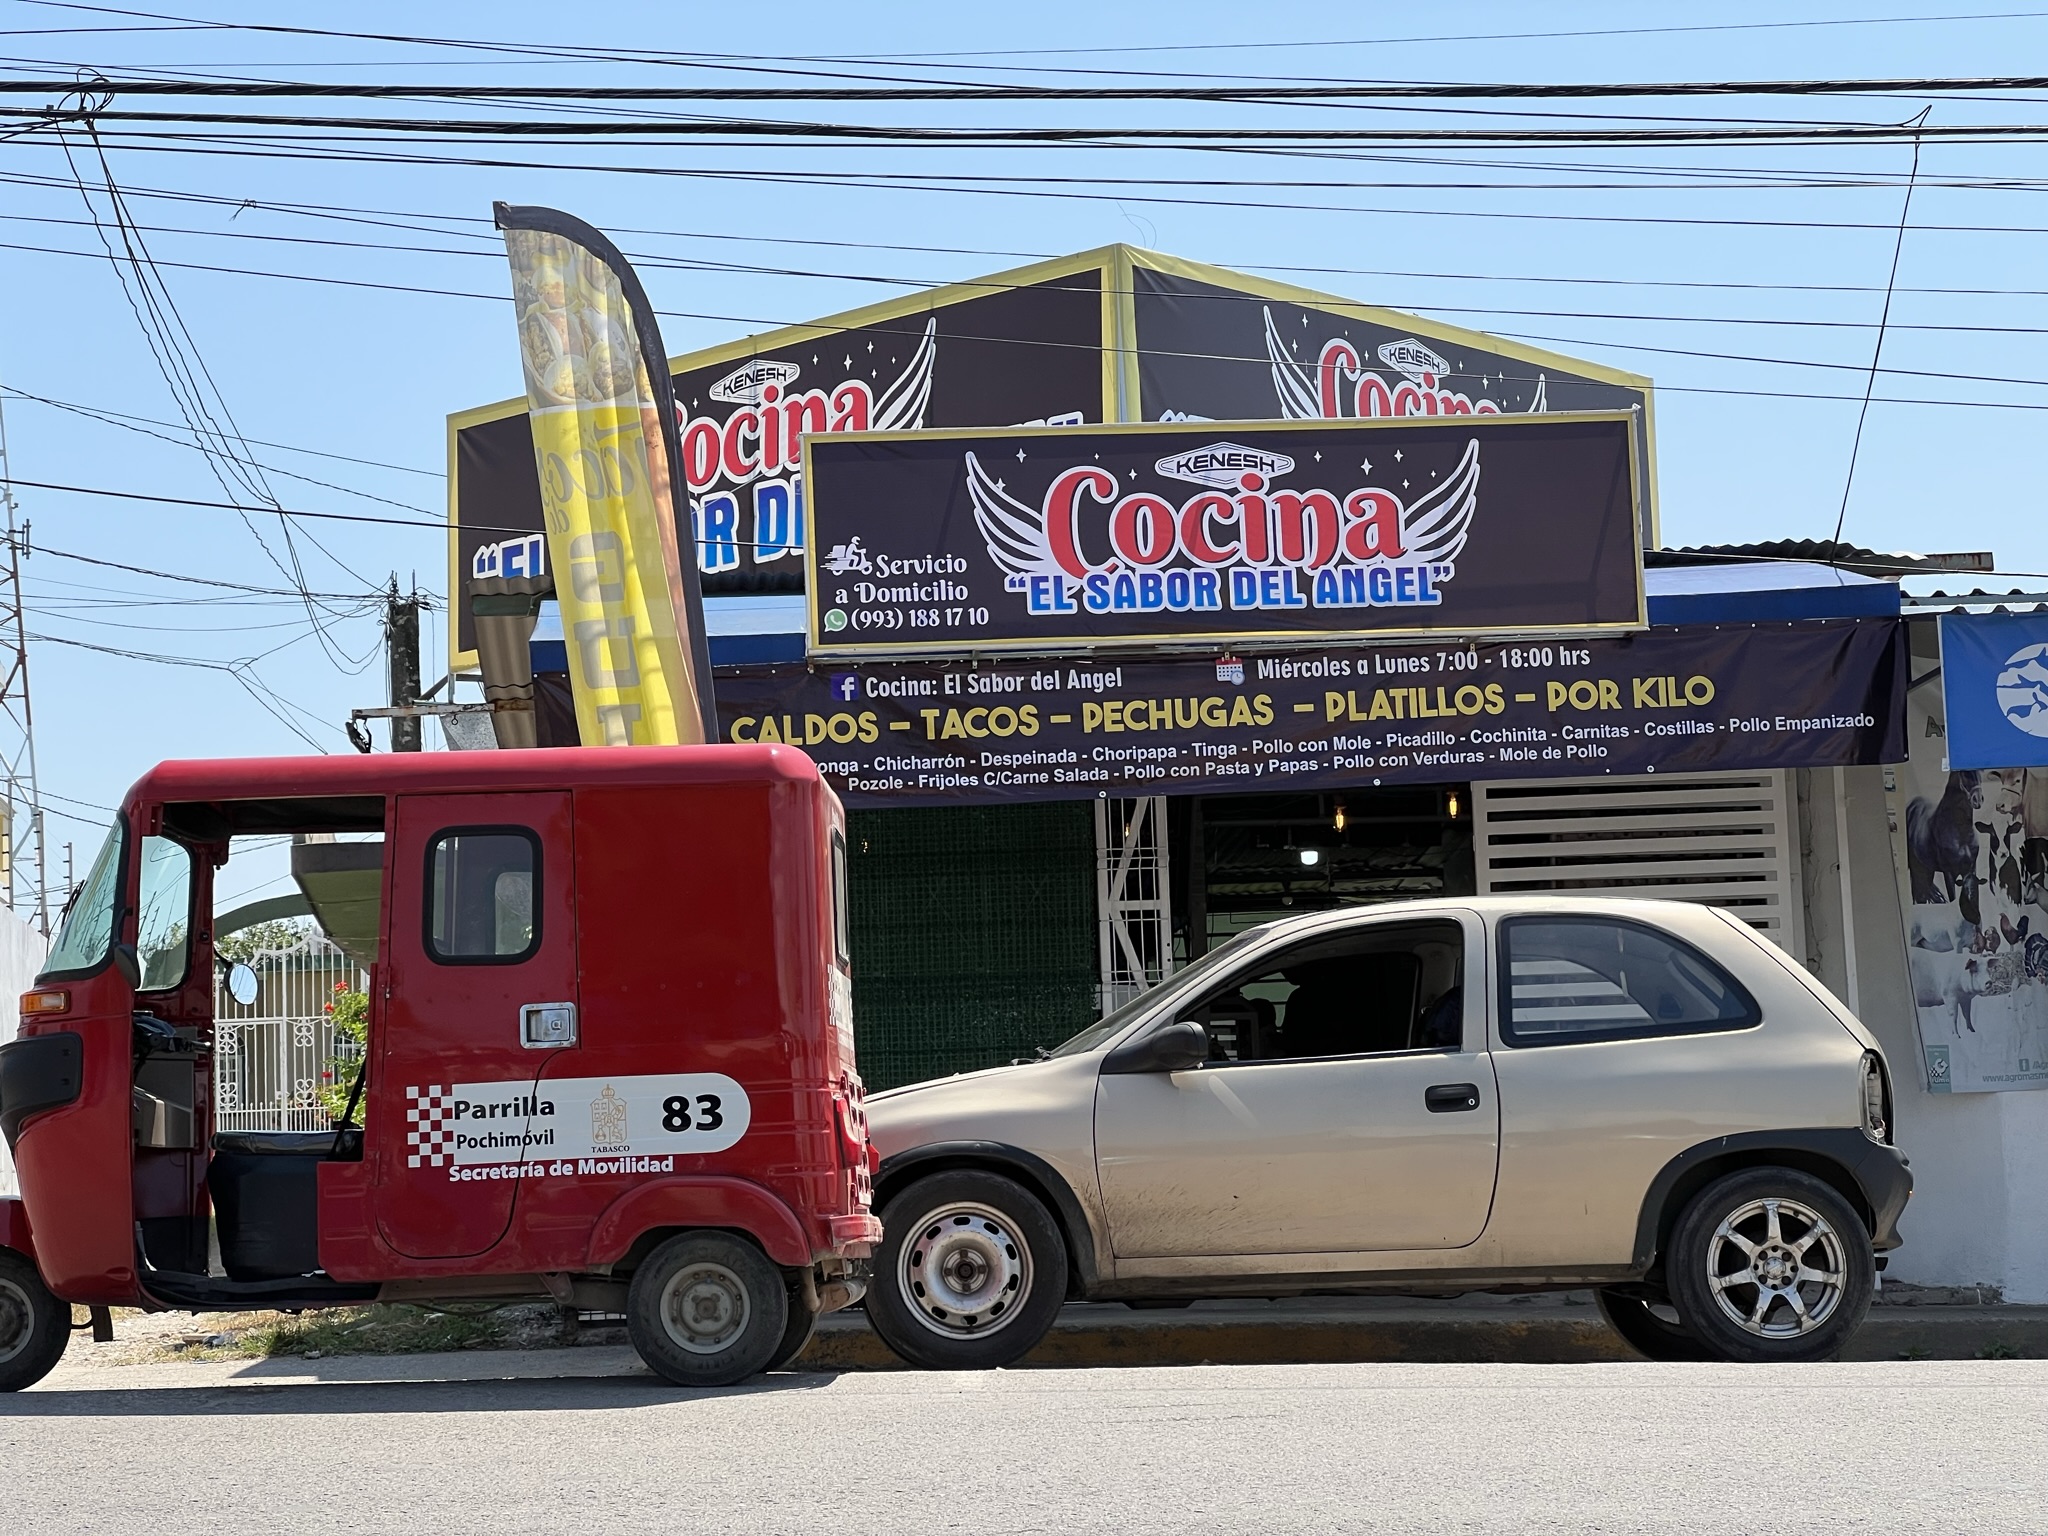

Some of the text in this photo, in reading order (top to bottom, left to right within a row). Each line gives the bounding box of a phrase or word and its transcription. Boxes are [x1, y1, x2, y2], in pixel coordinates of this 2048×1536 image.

[1388, 347, 1441, 374] KENESH
[722, 366, 787, 396] KENESH
[675, 384, 869, 486] ocina
[1177, 454, 1275, 473] KENESH
[1046, 469, 1407, 579] Cocina
[876, 554, 968, 578] Servicio
[835, 580, 969, 604] a Domicilio
[1086, 571, 1219, 610] SABOR
[1233, 569, 1303, 606] DEL
[851, 607, 990, 630] (993) 188 17 10
[1257, 654, 1352, 680] Miércoles
[1357, 661, 1369, 675] a
[1374, 653, 1430, 674] Lunes
[1436, 651, 1479, 672] 7:00
[1499, 647, 1553, 668] 18:00
[1559, 645, 1591, 666] hrs
[865, 667, 1123, 698] Cocina: El Sabor del Angel
[730, 711, 880, 745] CALDOS
[920, 704, 1040, 740] TACOS
[1083, 693, 1275, 734] PECHUGAS
[1325, 683, 1506, 722] PLATILLOS
[1546, 679, 1622, 712] POR
[1632, 675, 1716, 709] KILO
[873, 754, 965, 772] Chicharrón
[980, 748, 1078, 769] Despeinada
[1092, 745, 1177, 767] Choripapa
[1191, 742, 1237, 761] Tinga
[1252, 739, 1294, 755] Pollo
[1297, 741, 1329, 754] con
[1333, 736, 1372, 751] Mole
[1386, 731, 1455, 748] Picadillo
[1470, 725, 1547, 745] Cochinita
[1561, 723, 1630, 741] Carnitas
[1644, 719, 1715, 738] Costillas
[1729, 716, 1771, 733] Pollo
[1775, 712, 1875, 735] Empanizado
[848, 776, 903, 791] Pozole
[918, 773, 979, 790] Frijoles
[983, 769, 1049, 787] C/Carne
[1053, 767, 1110, 784] Salada
[1124, 763, 1166, 780] Pollo
[1170, 765, 1200, 778] con
[1205, 760, 1250, 776] Pasta
[1254, 763, 1264, 778] y
[1268, 757, 1319, 775] Papas
[1333, 754, 1375, 770] Pollo
[1378, 755, 1408, 768] con
[1412, 749, 1485, 766] Verduras
[1499, 746, 1538, 762] Mole
[1542, 744, 1562, 760] de
[1566, 742, 1608, 759] Pollo
[454, 1096, 555, 1120] Parrilla
[661, 1094, 724, 1133] 83
[456, 1129, 554, 1149] Pochimóvil
[591, 1145, 630, 1154] TABASCO
[449, 1155, 674, 1182] Secretaría de Movilidad
